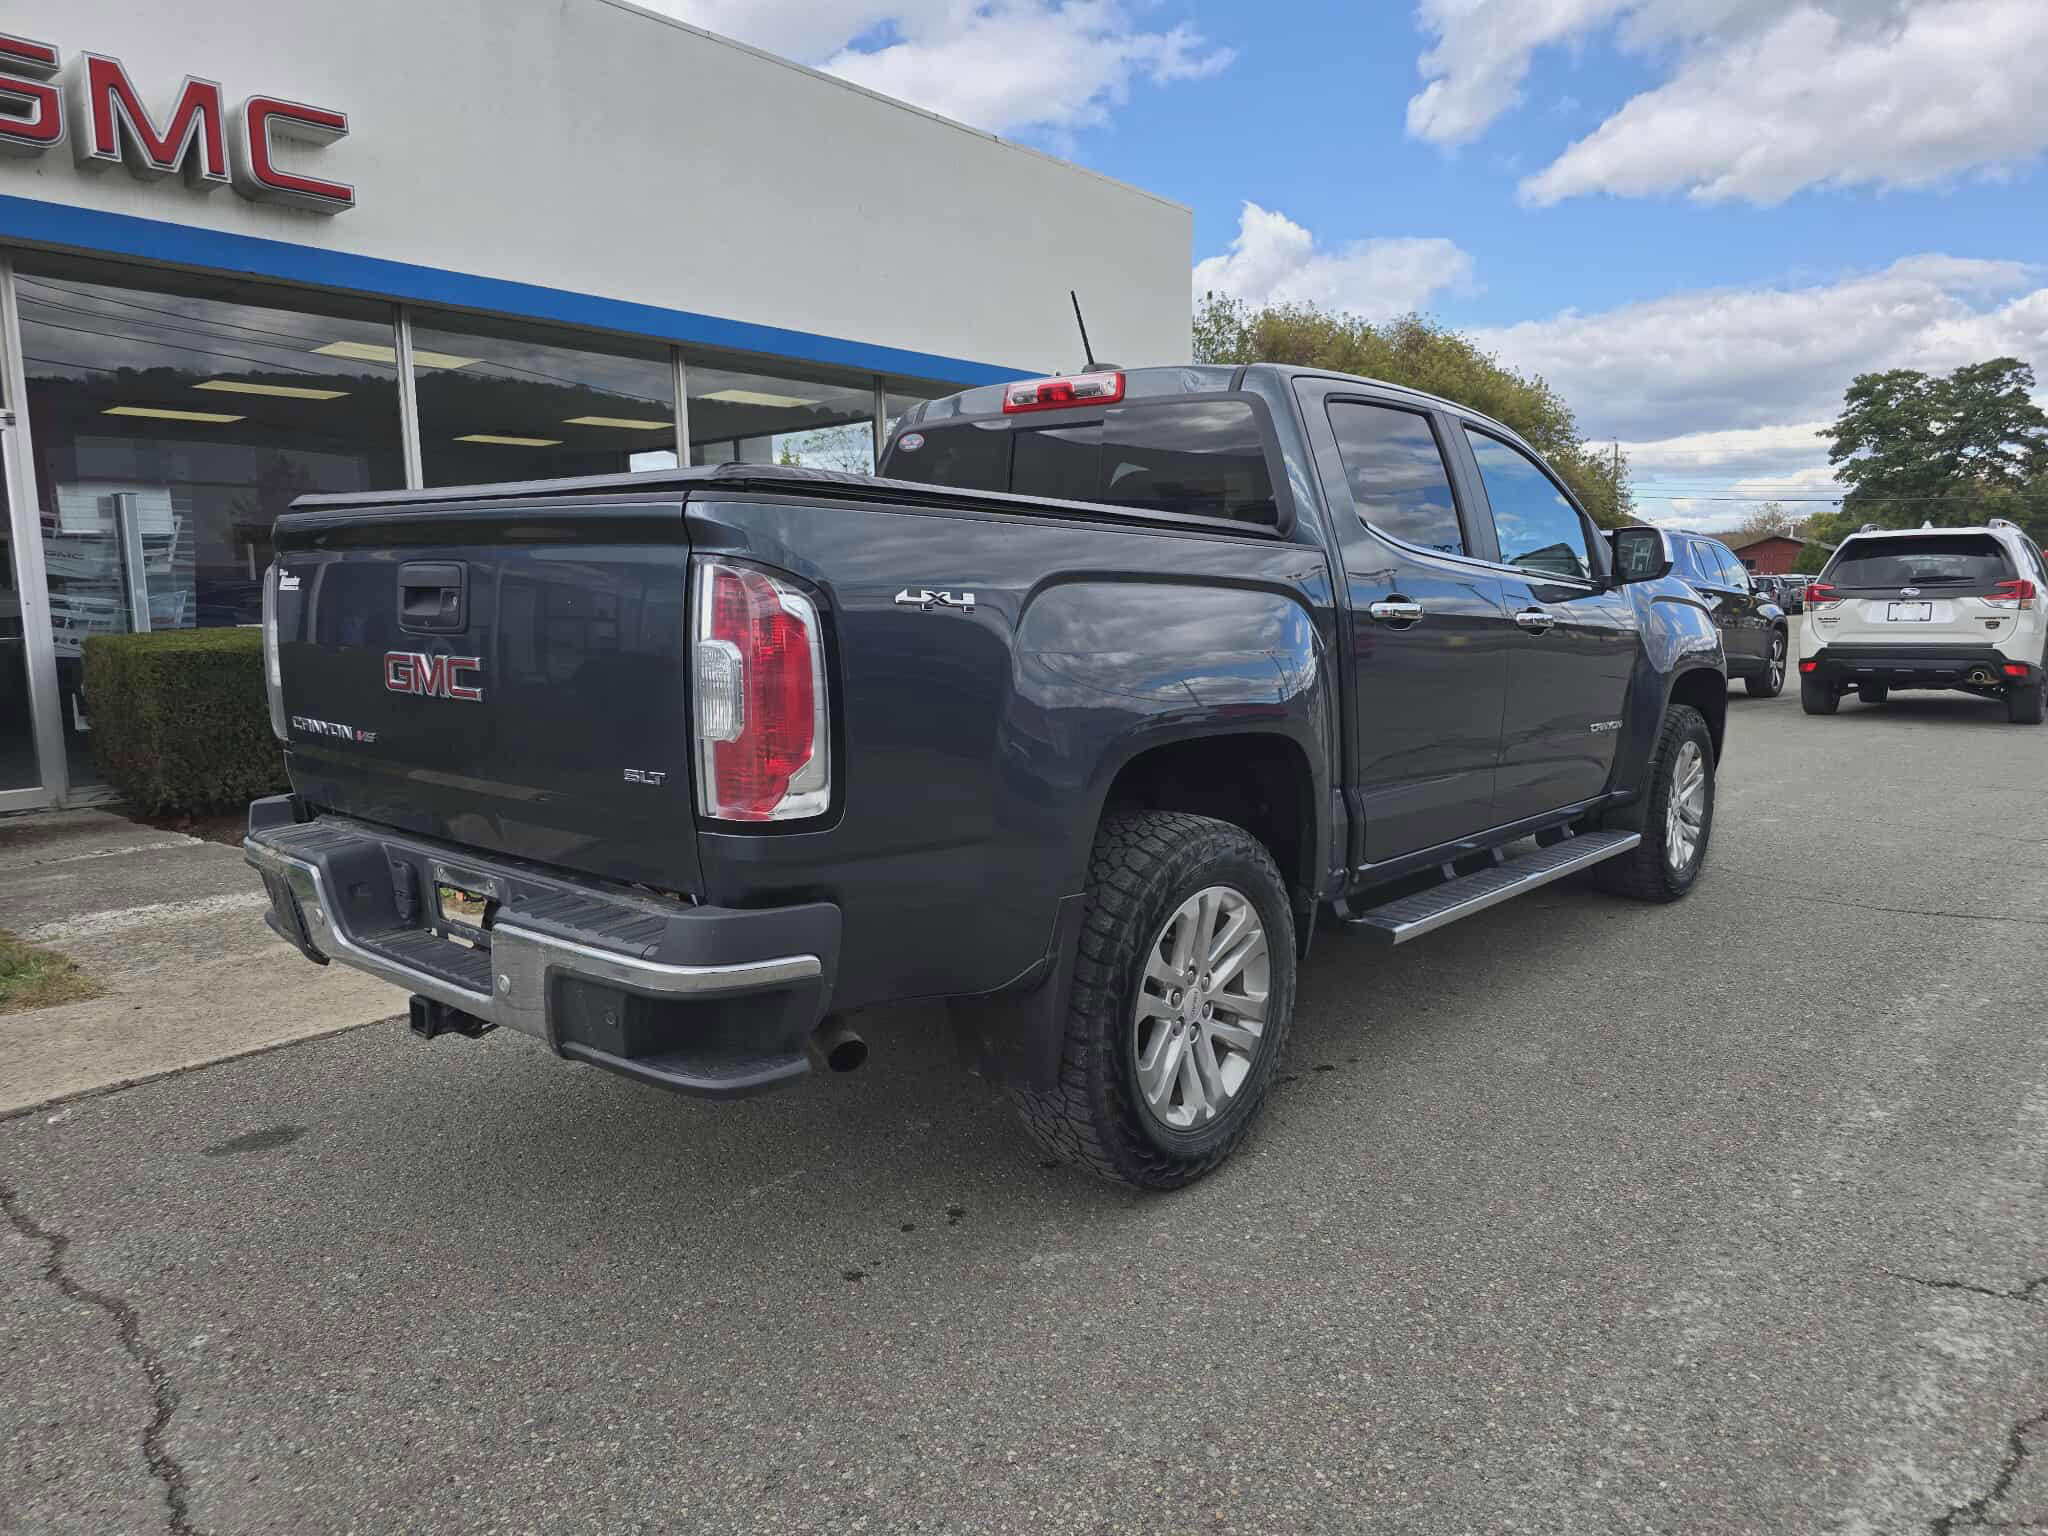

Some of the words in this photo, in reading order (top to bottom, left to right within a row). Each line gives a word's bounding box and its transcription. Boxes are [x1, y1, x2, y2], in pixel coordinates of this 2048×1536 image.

[384, 651, 482, 702] GMC
[291, 715, 353, 741] CANYON
[624, 768, 666, 785] SLT
